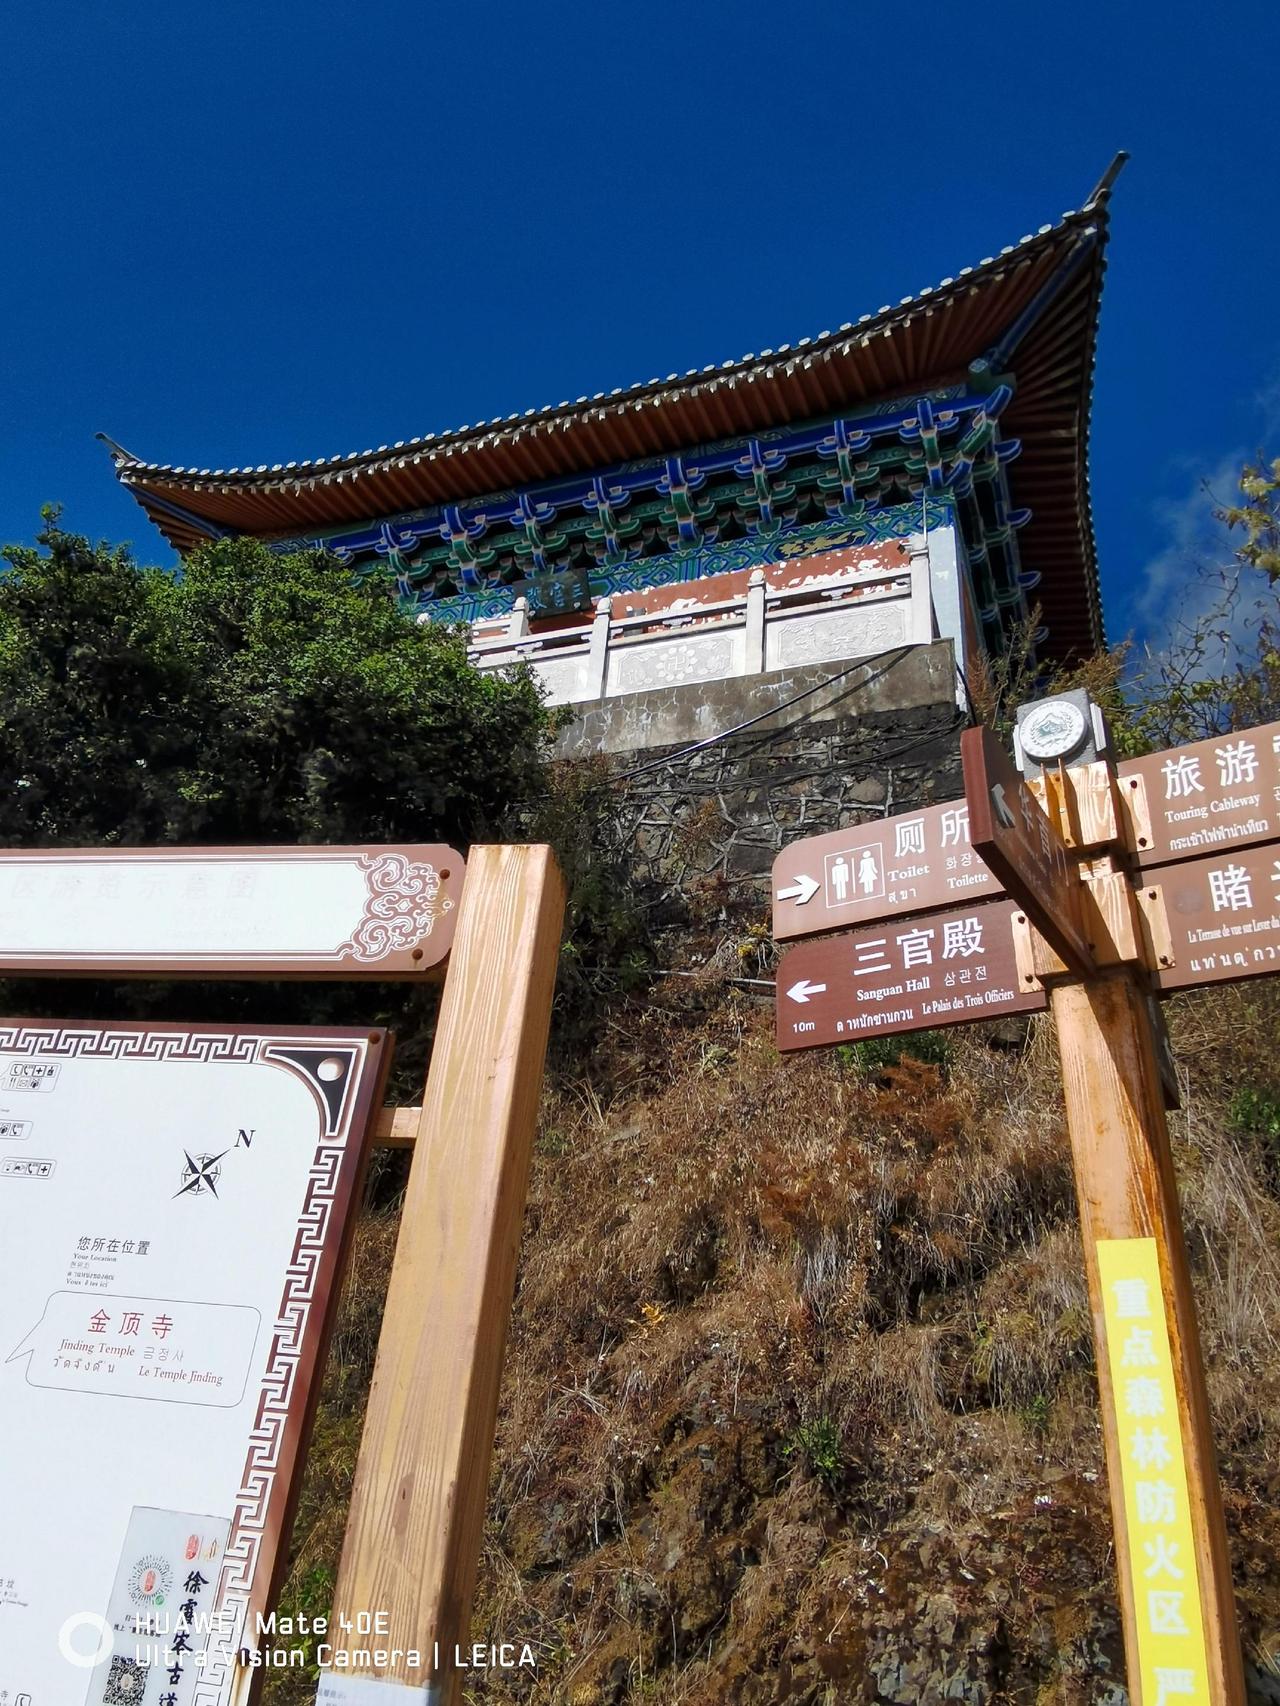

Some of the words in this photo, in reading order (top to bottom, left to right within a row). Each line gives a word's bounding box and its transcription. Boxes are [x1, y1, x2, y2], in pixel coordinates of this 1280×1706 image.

[1161, 735, 1280, 800] 旅游
[1164, 805, 1209, 823] Touring
[1209, 793, 1261, 813] Cableway
[888, 865, 930, 882] Toilet
[947, 873, 989, 889] Toilette
[853, 916, 985, 976] 三官殿
[856, 984, 904, 1002] Sanguan
[905, 976, 931, 993] Hall
[922, 1002, 932, 1015] Le
[931, 998, 953, 1014] Palais
[952, 996, 965, 1010] des
[964, 992, 985, 1008] Trois
[984, 988, 1016, 1004] Officiers
[793, 1021, 816, 1034] 10m
[234, 1129, 256, 1148] N
[73, 1252, 89, 1260] Your
[90, 1254, 117, 1263] Location
[76, 1236, 151, 1256] 您所在位置
[87, 1308, 175, 1340] 金顶寺
[58, 1338, 95, 1356] Jinding
[98, 1342, 136, 1358] Temple
[138, 1365, 150, 1378] Le
[152, 1367, 188, 1383] Temple
[189, 1370, 224, 1388] Jinding
[1112, 1277, 1190, 1636] 重点森林防火区
